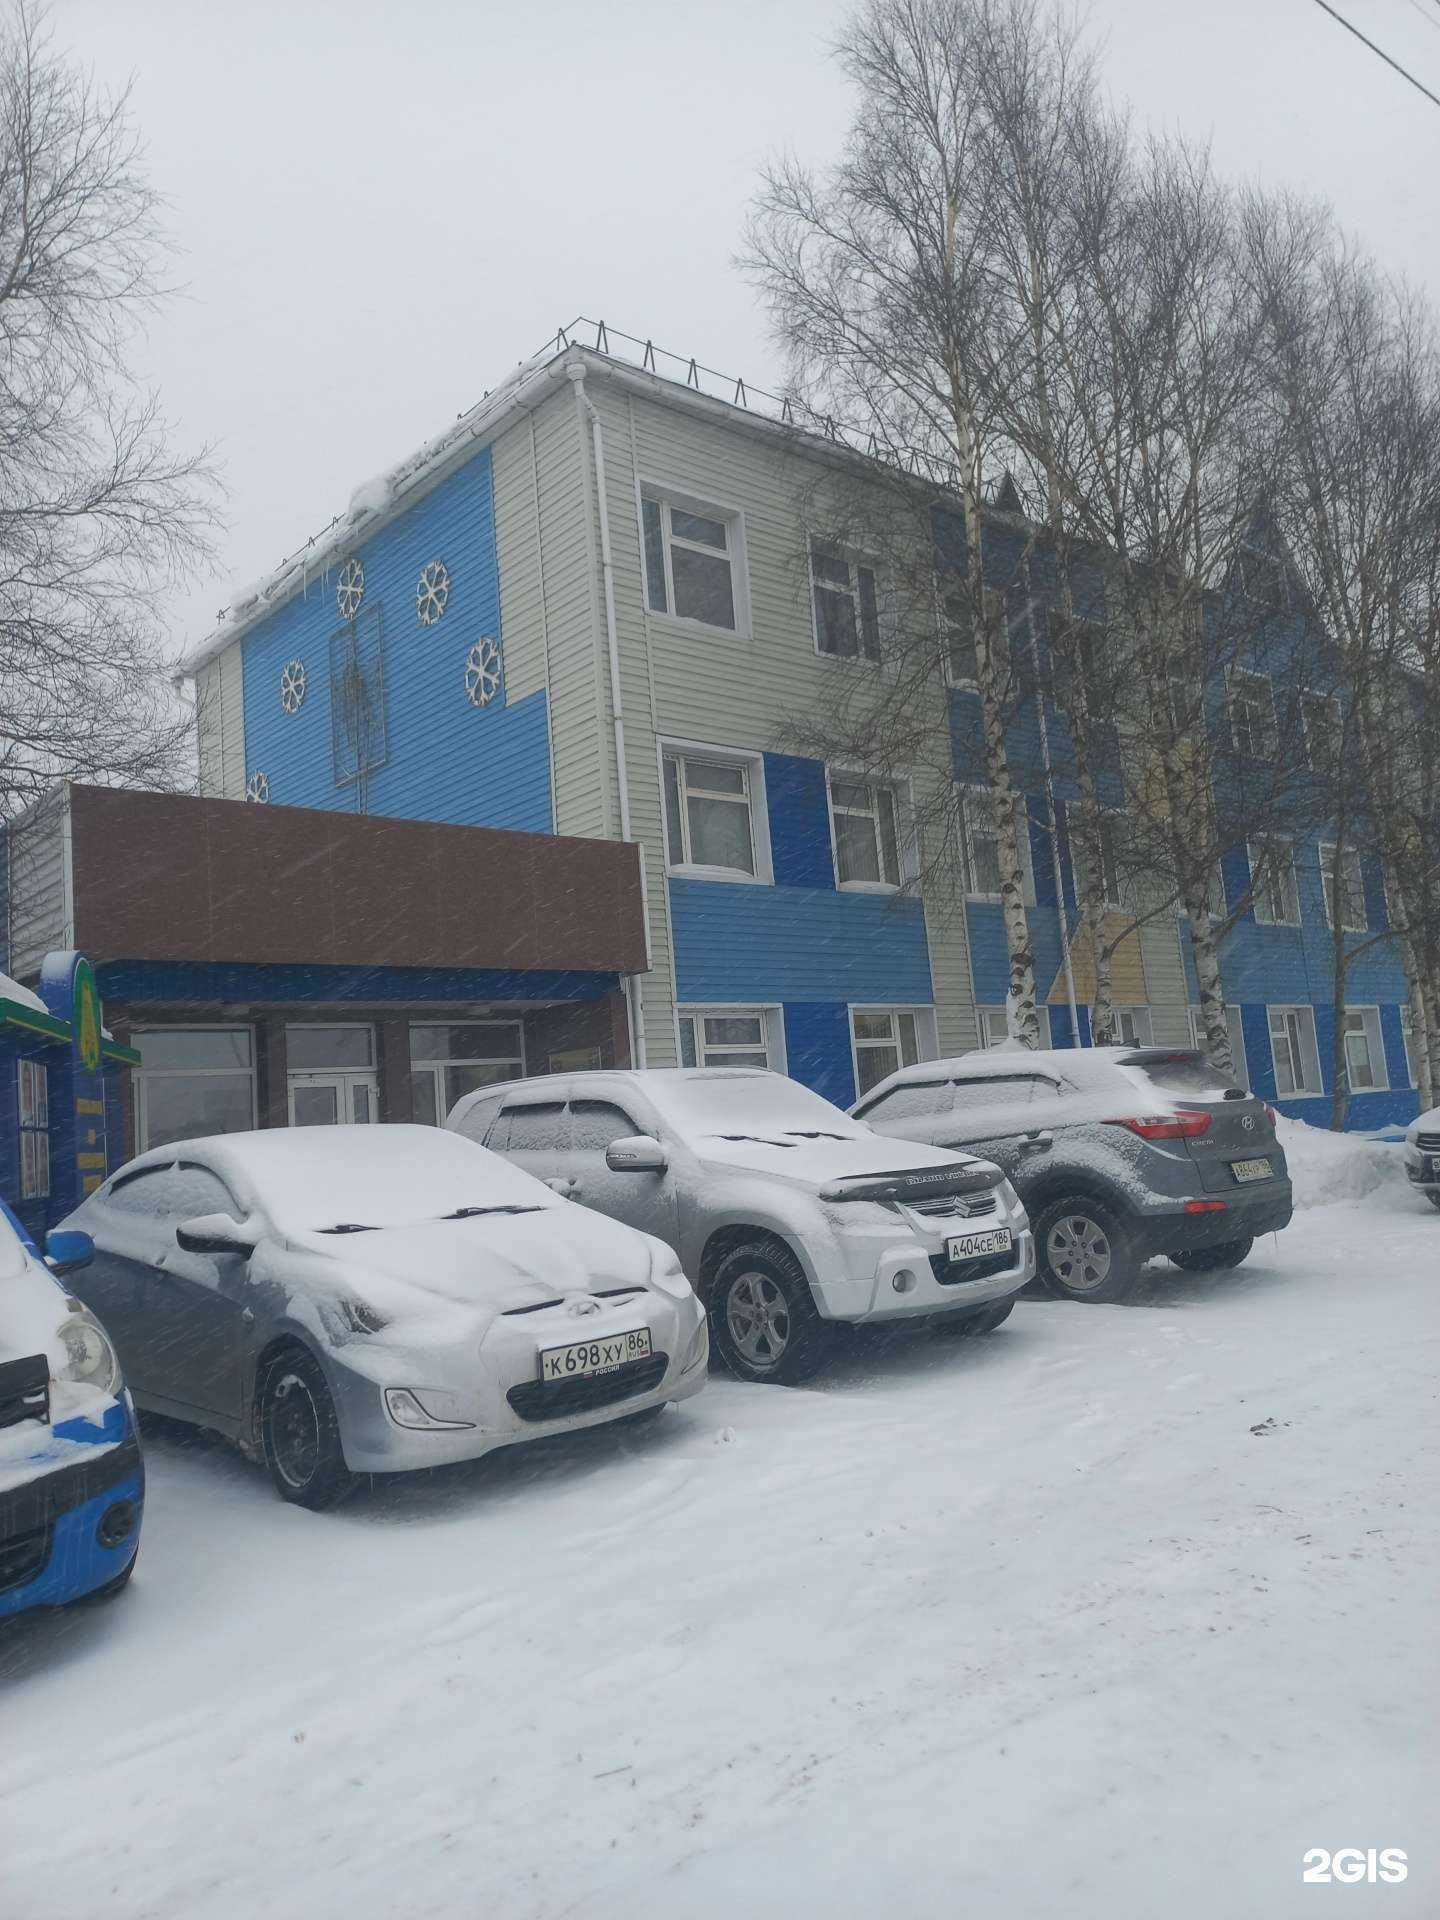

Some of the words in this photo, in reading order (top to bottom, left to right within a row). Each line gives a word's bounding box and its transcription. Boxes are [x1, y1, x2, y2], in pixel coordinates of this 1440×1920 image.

[953, 1237, 993, 1258] А404СЕ
[994, 1230, 1008, 1246] 186
[551, 1343, 623, 1376] К698ХУ
[628, 1333, 645, 1350] 86
